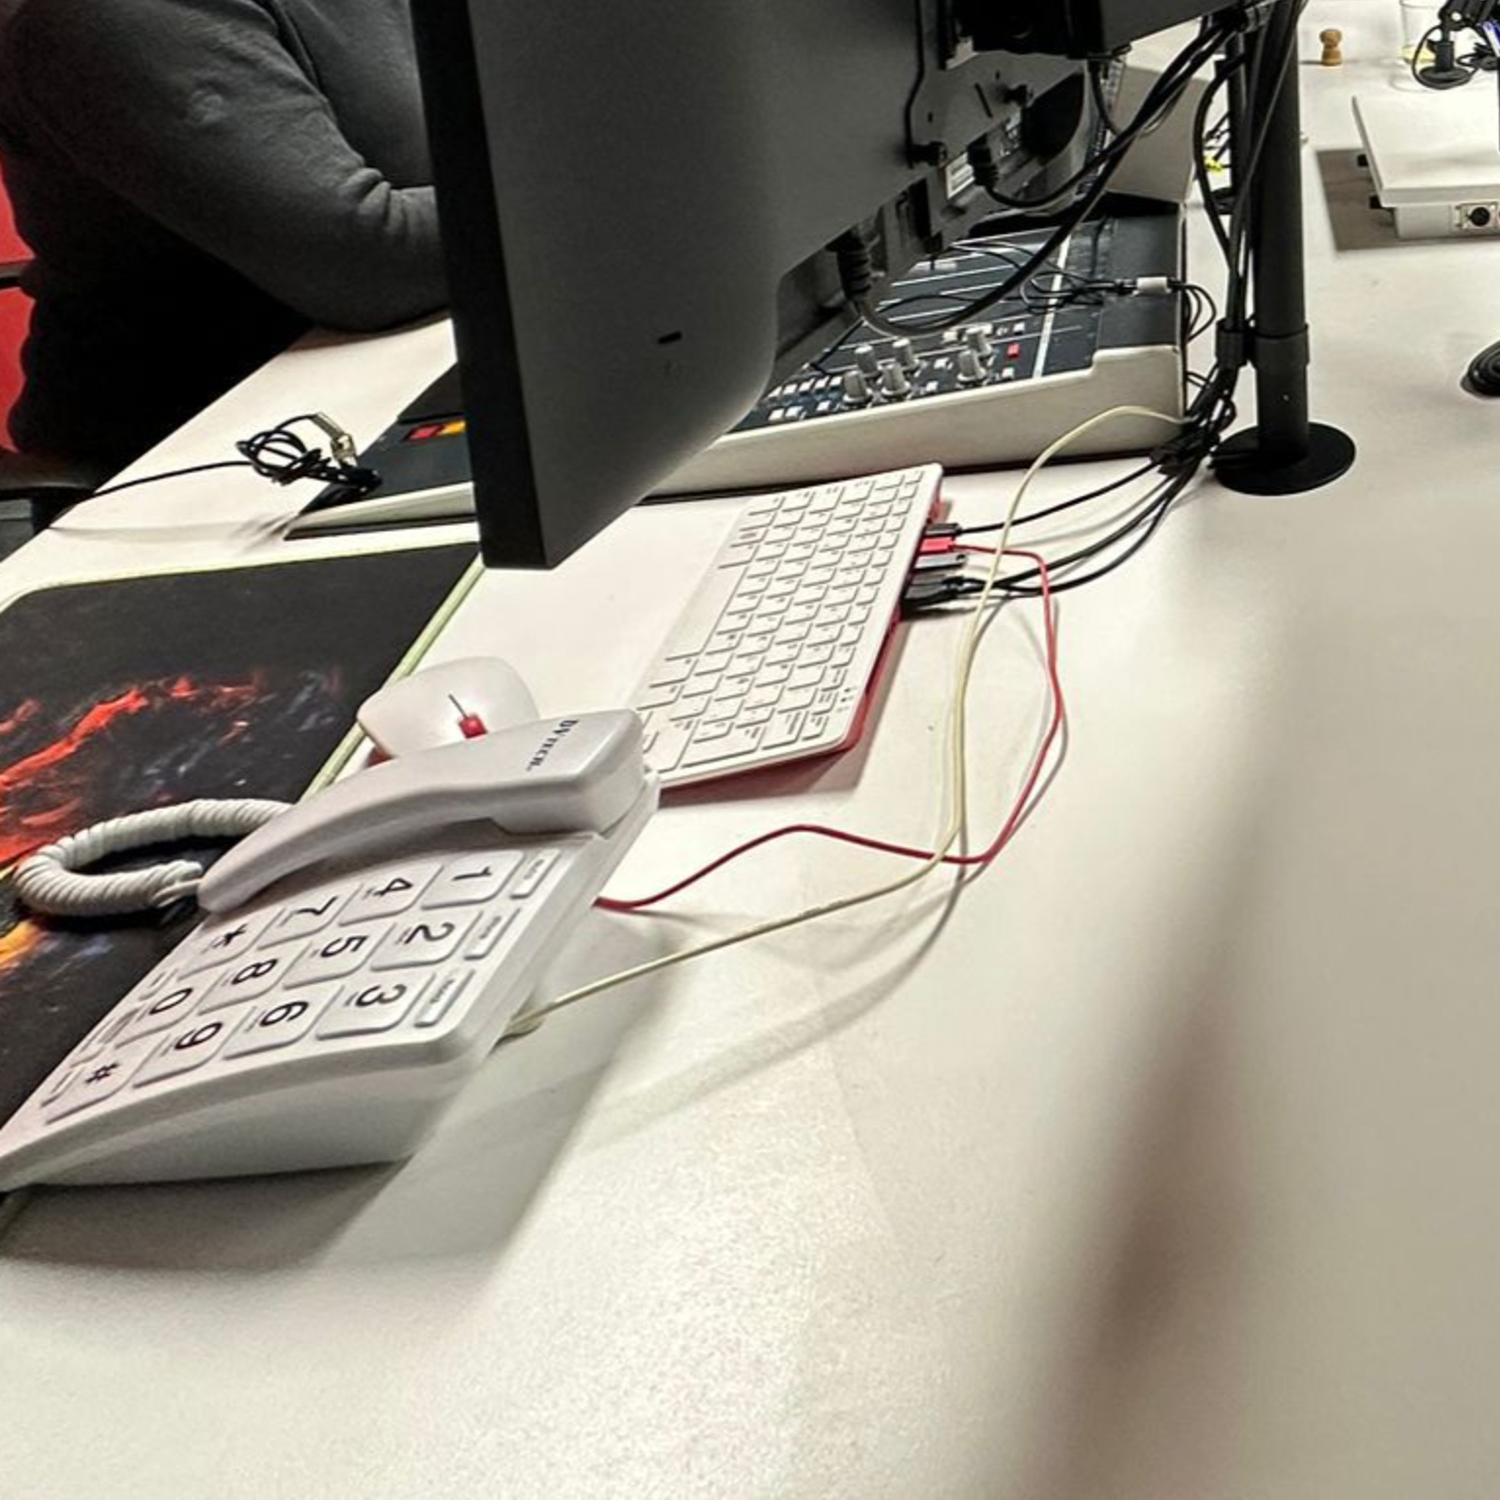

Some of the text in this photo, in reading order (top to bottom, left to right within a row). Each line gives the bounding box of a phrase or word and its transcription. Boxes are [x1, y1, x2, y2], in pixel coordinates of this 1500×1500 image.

[452, 866, 493, 882] 1
[373, 877, 414, 897] 4
[295, 895, 339, 916] 7
[404, 921, 456, 945] 2
[320, 934, 370, 958] 5
[230, 957, 279, 986] 8
[355, 983, 408, 1008] 3
[259, 1000, 310, 1027] 6
[173, 1021, 224, 1050] 9
